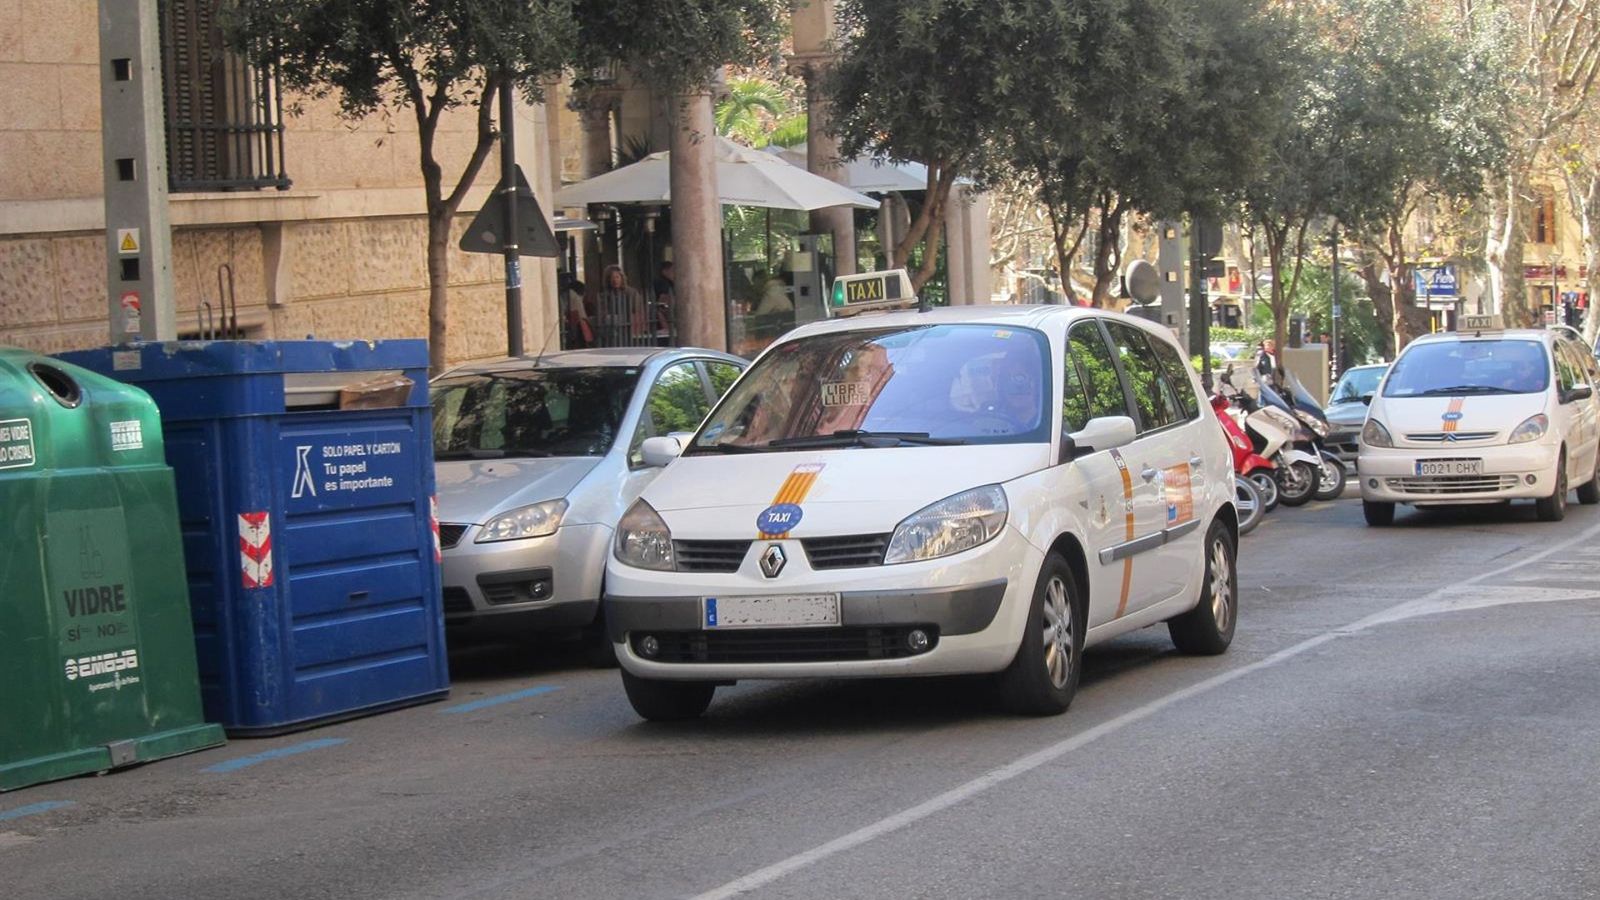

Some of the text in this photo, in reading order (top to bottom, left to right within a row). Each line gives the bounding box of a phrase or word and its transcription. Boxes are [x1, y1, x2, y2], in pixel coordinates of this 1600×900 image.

[848, 280, 882, 300] TAXI
[1468, 317, 1492, 328] TAXI
[826, 383, 865, 395] LIBRE
[824, 394, 868, 406] LLIURE
[323, 446, 343, 458] SOLO
[344, 444, 366, 457] PAPEL
[366, 444, 372, 455] Y
[323, 460, 367, 476] Tu papel
[1422, 461, 1479, 475] 0021 CHX
[325, 476, 393, 492] es importante
[768, 513, 791, 523] TAXI
[64, 584, 126, 617] VIDRE
[97, 623, 117, 638] NO
